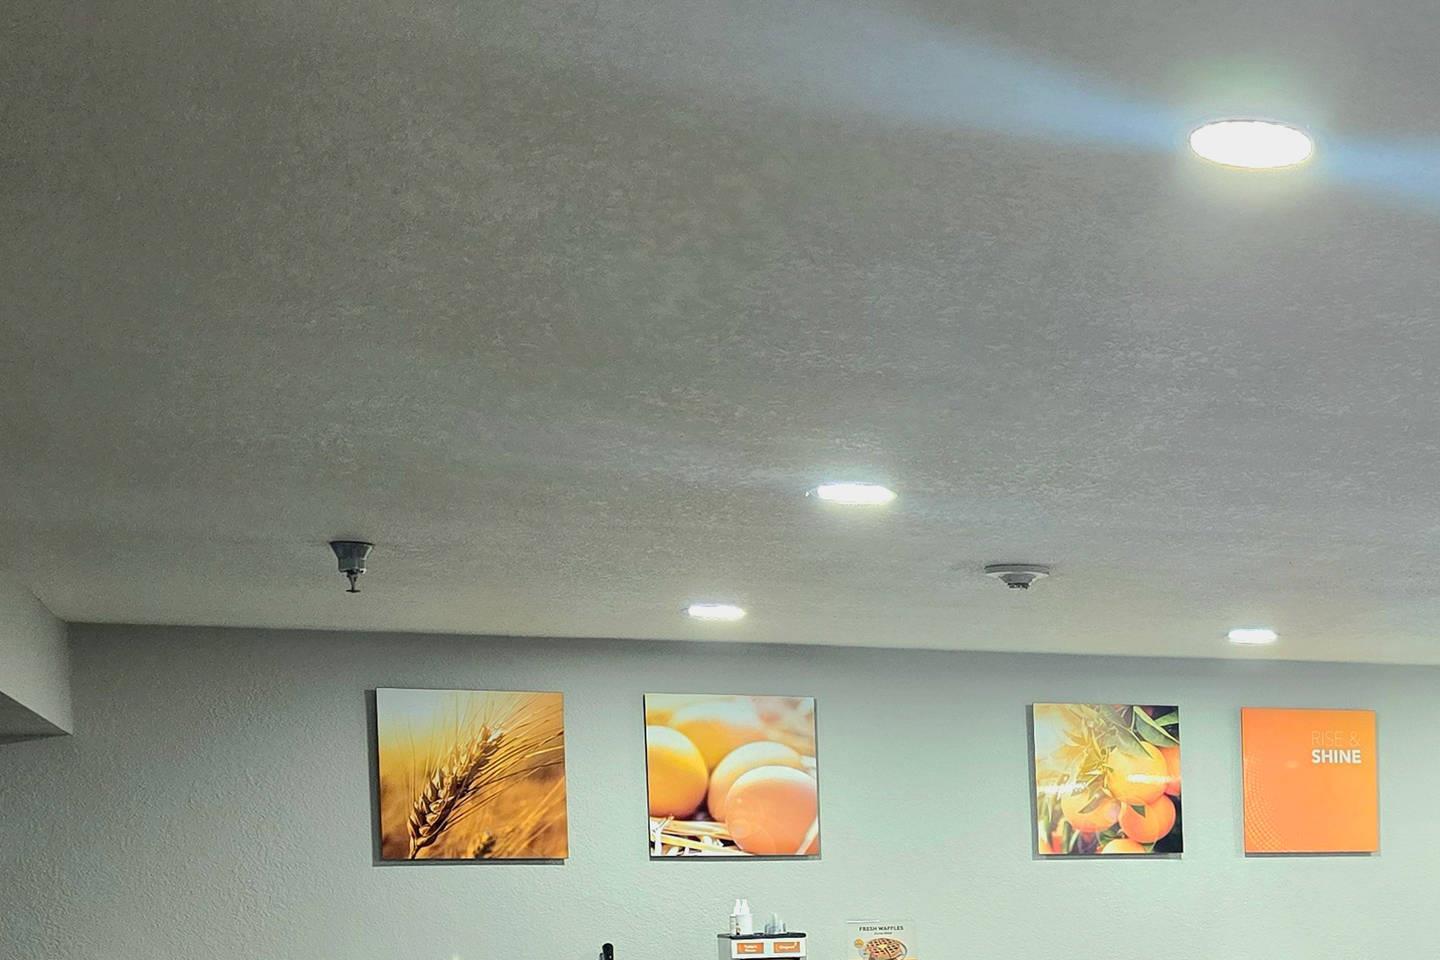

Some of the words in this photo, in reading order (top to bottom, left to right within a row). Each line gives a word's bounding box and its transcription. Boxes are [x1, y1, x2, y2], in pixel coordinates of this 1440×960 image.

[1312, 730, 1344, 747] RISE
[1350, 730, 1361, 747] &
[1311, 749, 1362, 764] SHINE
